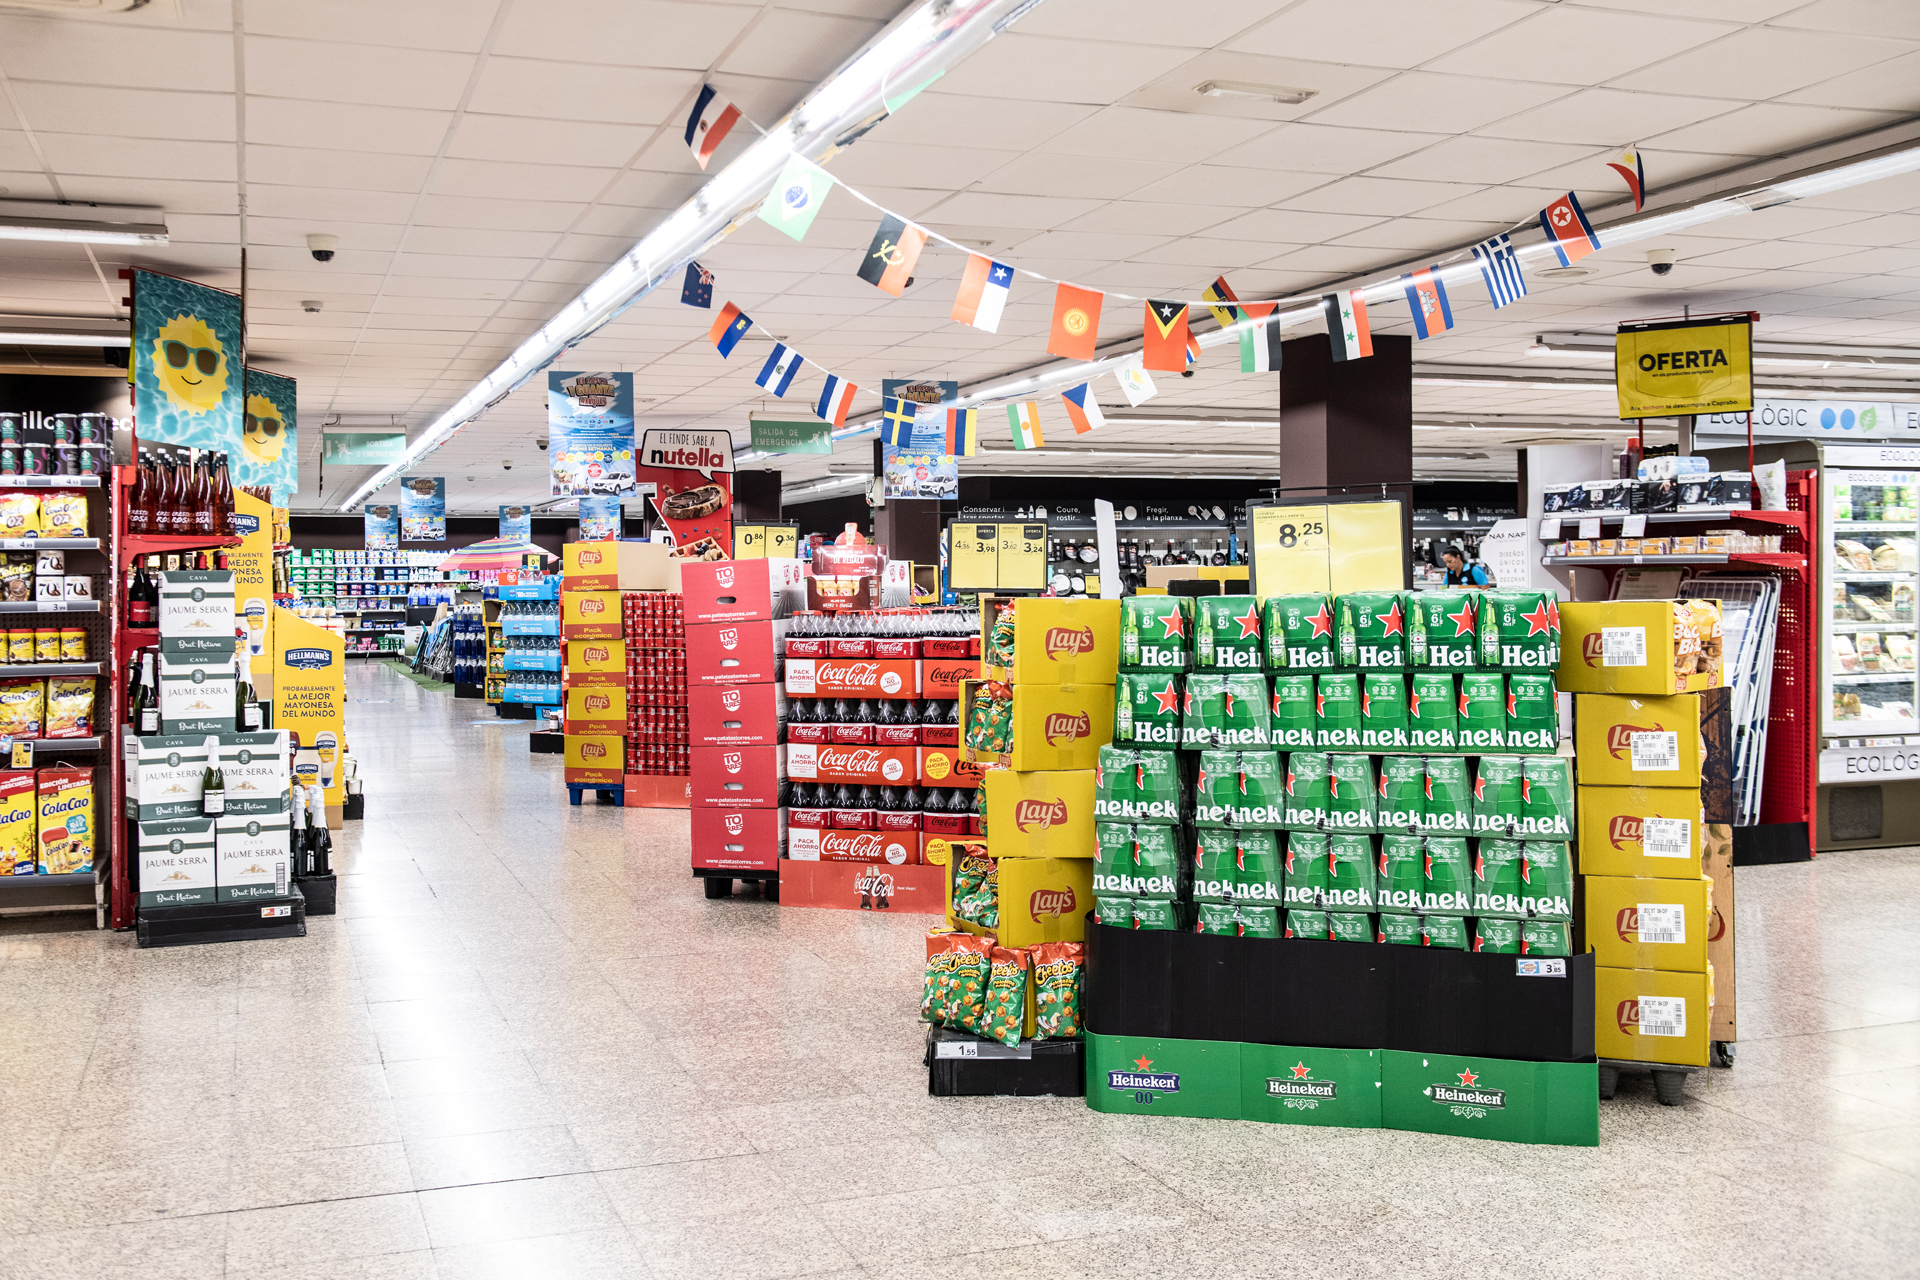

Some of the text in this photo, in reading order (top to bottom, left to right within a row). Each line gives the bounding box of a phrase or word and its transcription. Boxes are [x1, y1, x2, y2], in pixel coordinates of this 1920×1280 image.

[1638, 348, 1728, 372] OFERTA
[1673, 402, 1706, 410] descompte
[1712, 399, 1738, 407] Caprabo.
[1710, 404, 1808, 426] ECOLÒGIC
[660, 433, 714, 446] EL FINDE SABE A
[755, 438, 803, 446] EMERGENCIA
[651, 448, 723, 467] nutella
[1279, 522, 1323, 548] 8,25
[976, 542, 995, 553] 3,98
[1024, 542, 1043, 553] 3,24
[1049, 629, 1092, 657] Lay's
[288, 651, 330, 661] HELLMANN'S
[816, 662, 880, 685] Coca-Cola
[168, 688, 197, 697] JAUME
[723, 692, 739, 702] TO
[1137, 691, 1143, 700] 6
[586, 696, 610, 711] Lay's
[837, 727, 863, 736] Coca-Cola
[886, 729, 913, 738] Coca-Cola
[1049, 714, 1088, 742] Lay's
[582, 743, 606, 759] Lay's
[818, 748, 883, 772] Coca-Cola
[927, 761, 949, 769] AHORRO
[246, 768, 273, 776] SERRA
[40, 779, 68, 789] EDICIÓN
[58, 779, 90, 790] LIMITADA
[42, 798, 89, 816] ColaCao
[155, 806, 173, 815] Brut
[243, 803, 268, 811] Nature
[726, 816, 741, 825] TO
[795, 811, 821, 821] Coca-Cola
[886, 815, 913, 824] Coca-Cola
[1018, 800, 1064, 830] Lay's
[46, 841, 68, 855] ColaCao
[821, 833, 885, 857] Coca-Cola
[224, 849, 284, 860] JAUME SERRA
[146, 857, 208, 869] JAUME SERRA
[157, 892, 201, 903] Brut Nature
[231, 887, 274, 898] Brut Nature
[1032, 890, 1073, 918] Lay's
[949, 952, 982, 971] Cheetos
[1036, 961, 1074, 984] Cheetos
[1112, 1074, 1176, 1088] Heineken
[1269, 1083, 1333, 1096] Heineken
[1135, 1091, 1153, 1105] 0.0
[1435, 1088, 1501, 1105] Heineken
